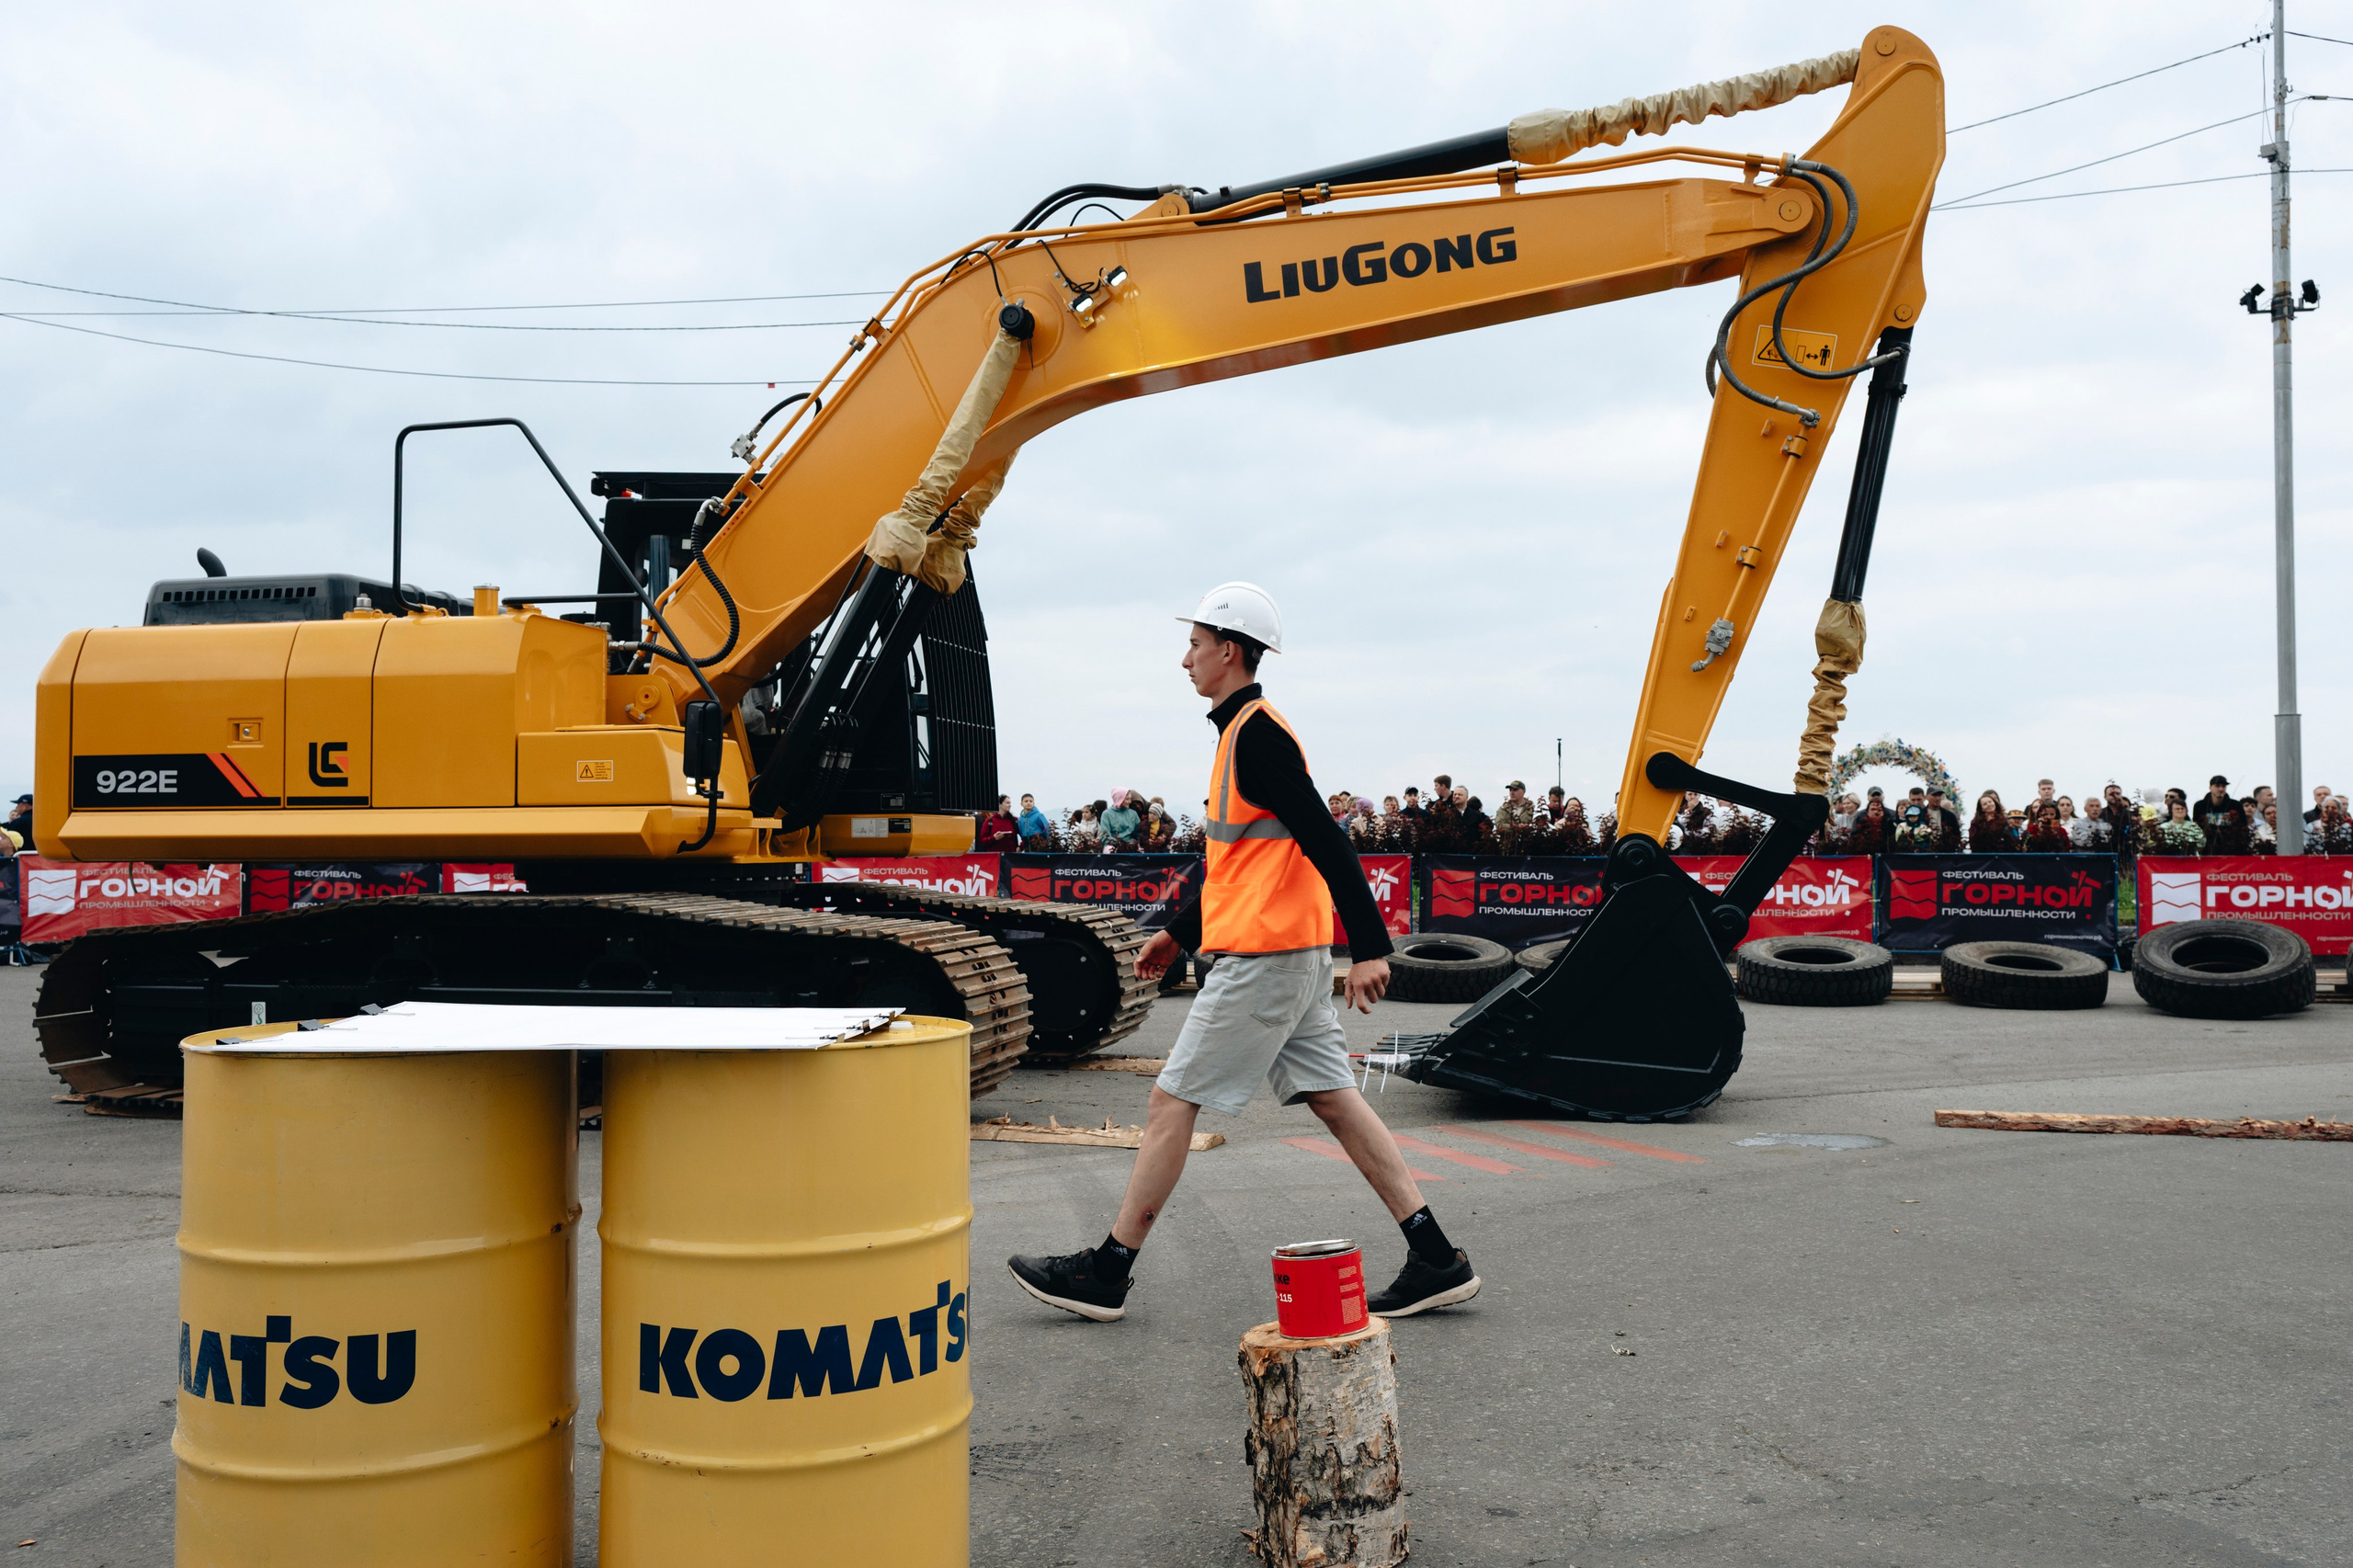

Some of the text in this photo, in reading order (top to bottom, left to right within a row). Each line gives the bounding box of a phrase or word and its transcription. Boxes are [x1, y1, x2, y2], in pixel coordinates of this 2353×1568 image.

[97, 770, 177, 793] 922E
[294, 870, 361, 879] ФЕСТИВАЛЬ
[1055, 869, 1121, 877] ФЕСТИВАЛЬ
[1480, 871, 1554, 881] ФЕСТИВАЛЬ
[1942, 870, 2025, 881] ФЕСТИВАЛЬ
[2206, 873, 2294, 882] ФЕСТИВАЛЬ
[80, 864, 229, 899] ГОРНОЙ
[1054, 867, 1188, 902] ГОРНОЙ
[1942, 870, 2102, 908] ГОРНОЙ
[79, 899, 205, 909] ПРОМЫШЛЕННОСТИ
[1479, 906, 1594, 917] ПРОМЫШЛЕННОСТ
[1941, 907, 2076, 919] ПРОМЫШЛЕННОСТИ
[2206, 911, 2351, 921] ПРОМЫШЛЕННОСТИ
[640, 1278, 971, 1403] KOMATS
